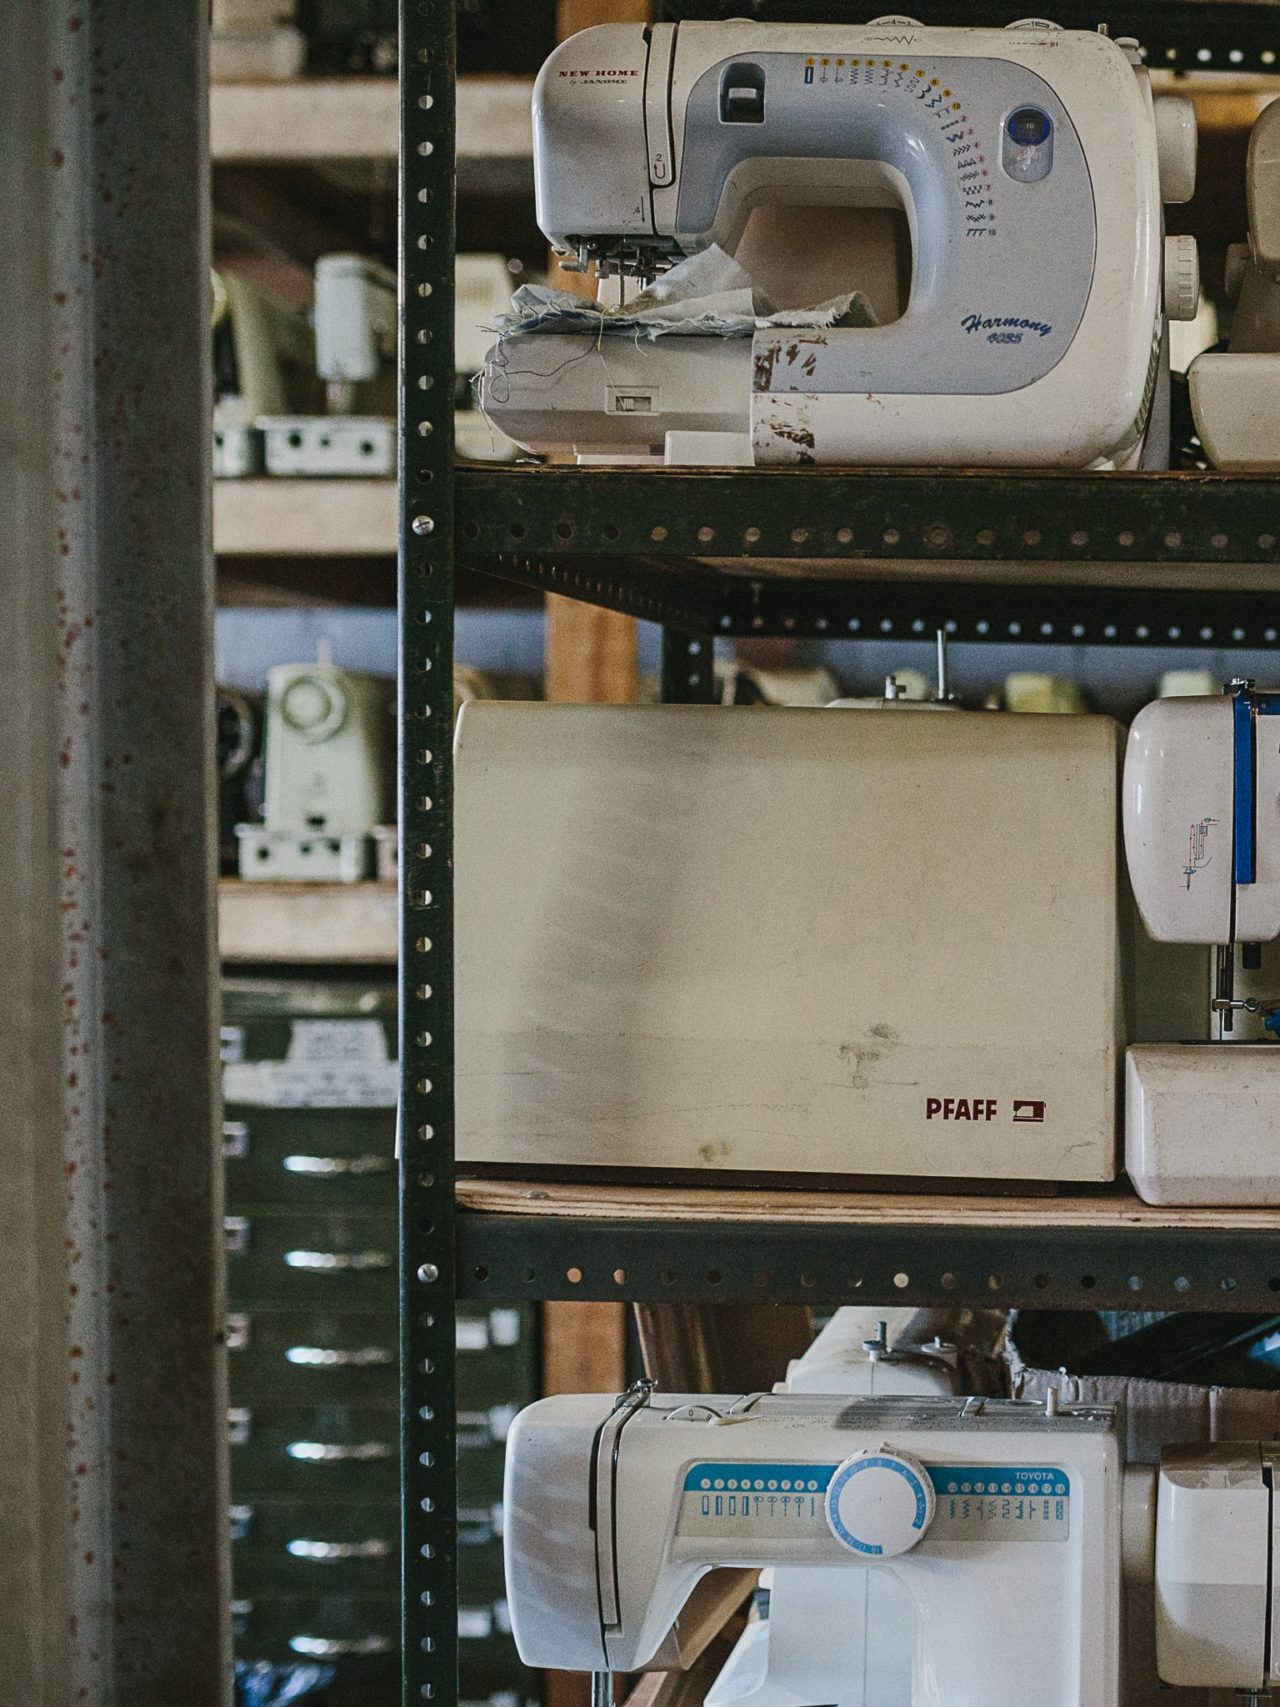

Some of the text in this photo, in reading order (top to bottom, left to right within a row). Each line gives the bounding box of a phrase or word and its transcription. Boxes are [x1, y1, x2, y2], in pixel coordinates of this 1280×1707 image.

[961, 314, 1052, 337] Harmony
[926, 1098, 997, 1121] PFAFF
[1015, 1472, 1054, 1480] TOYOTA
